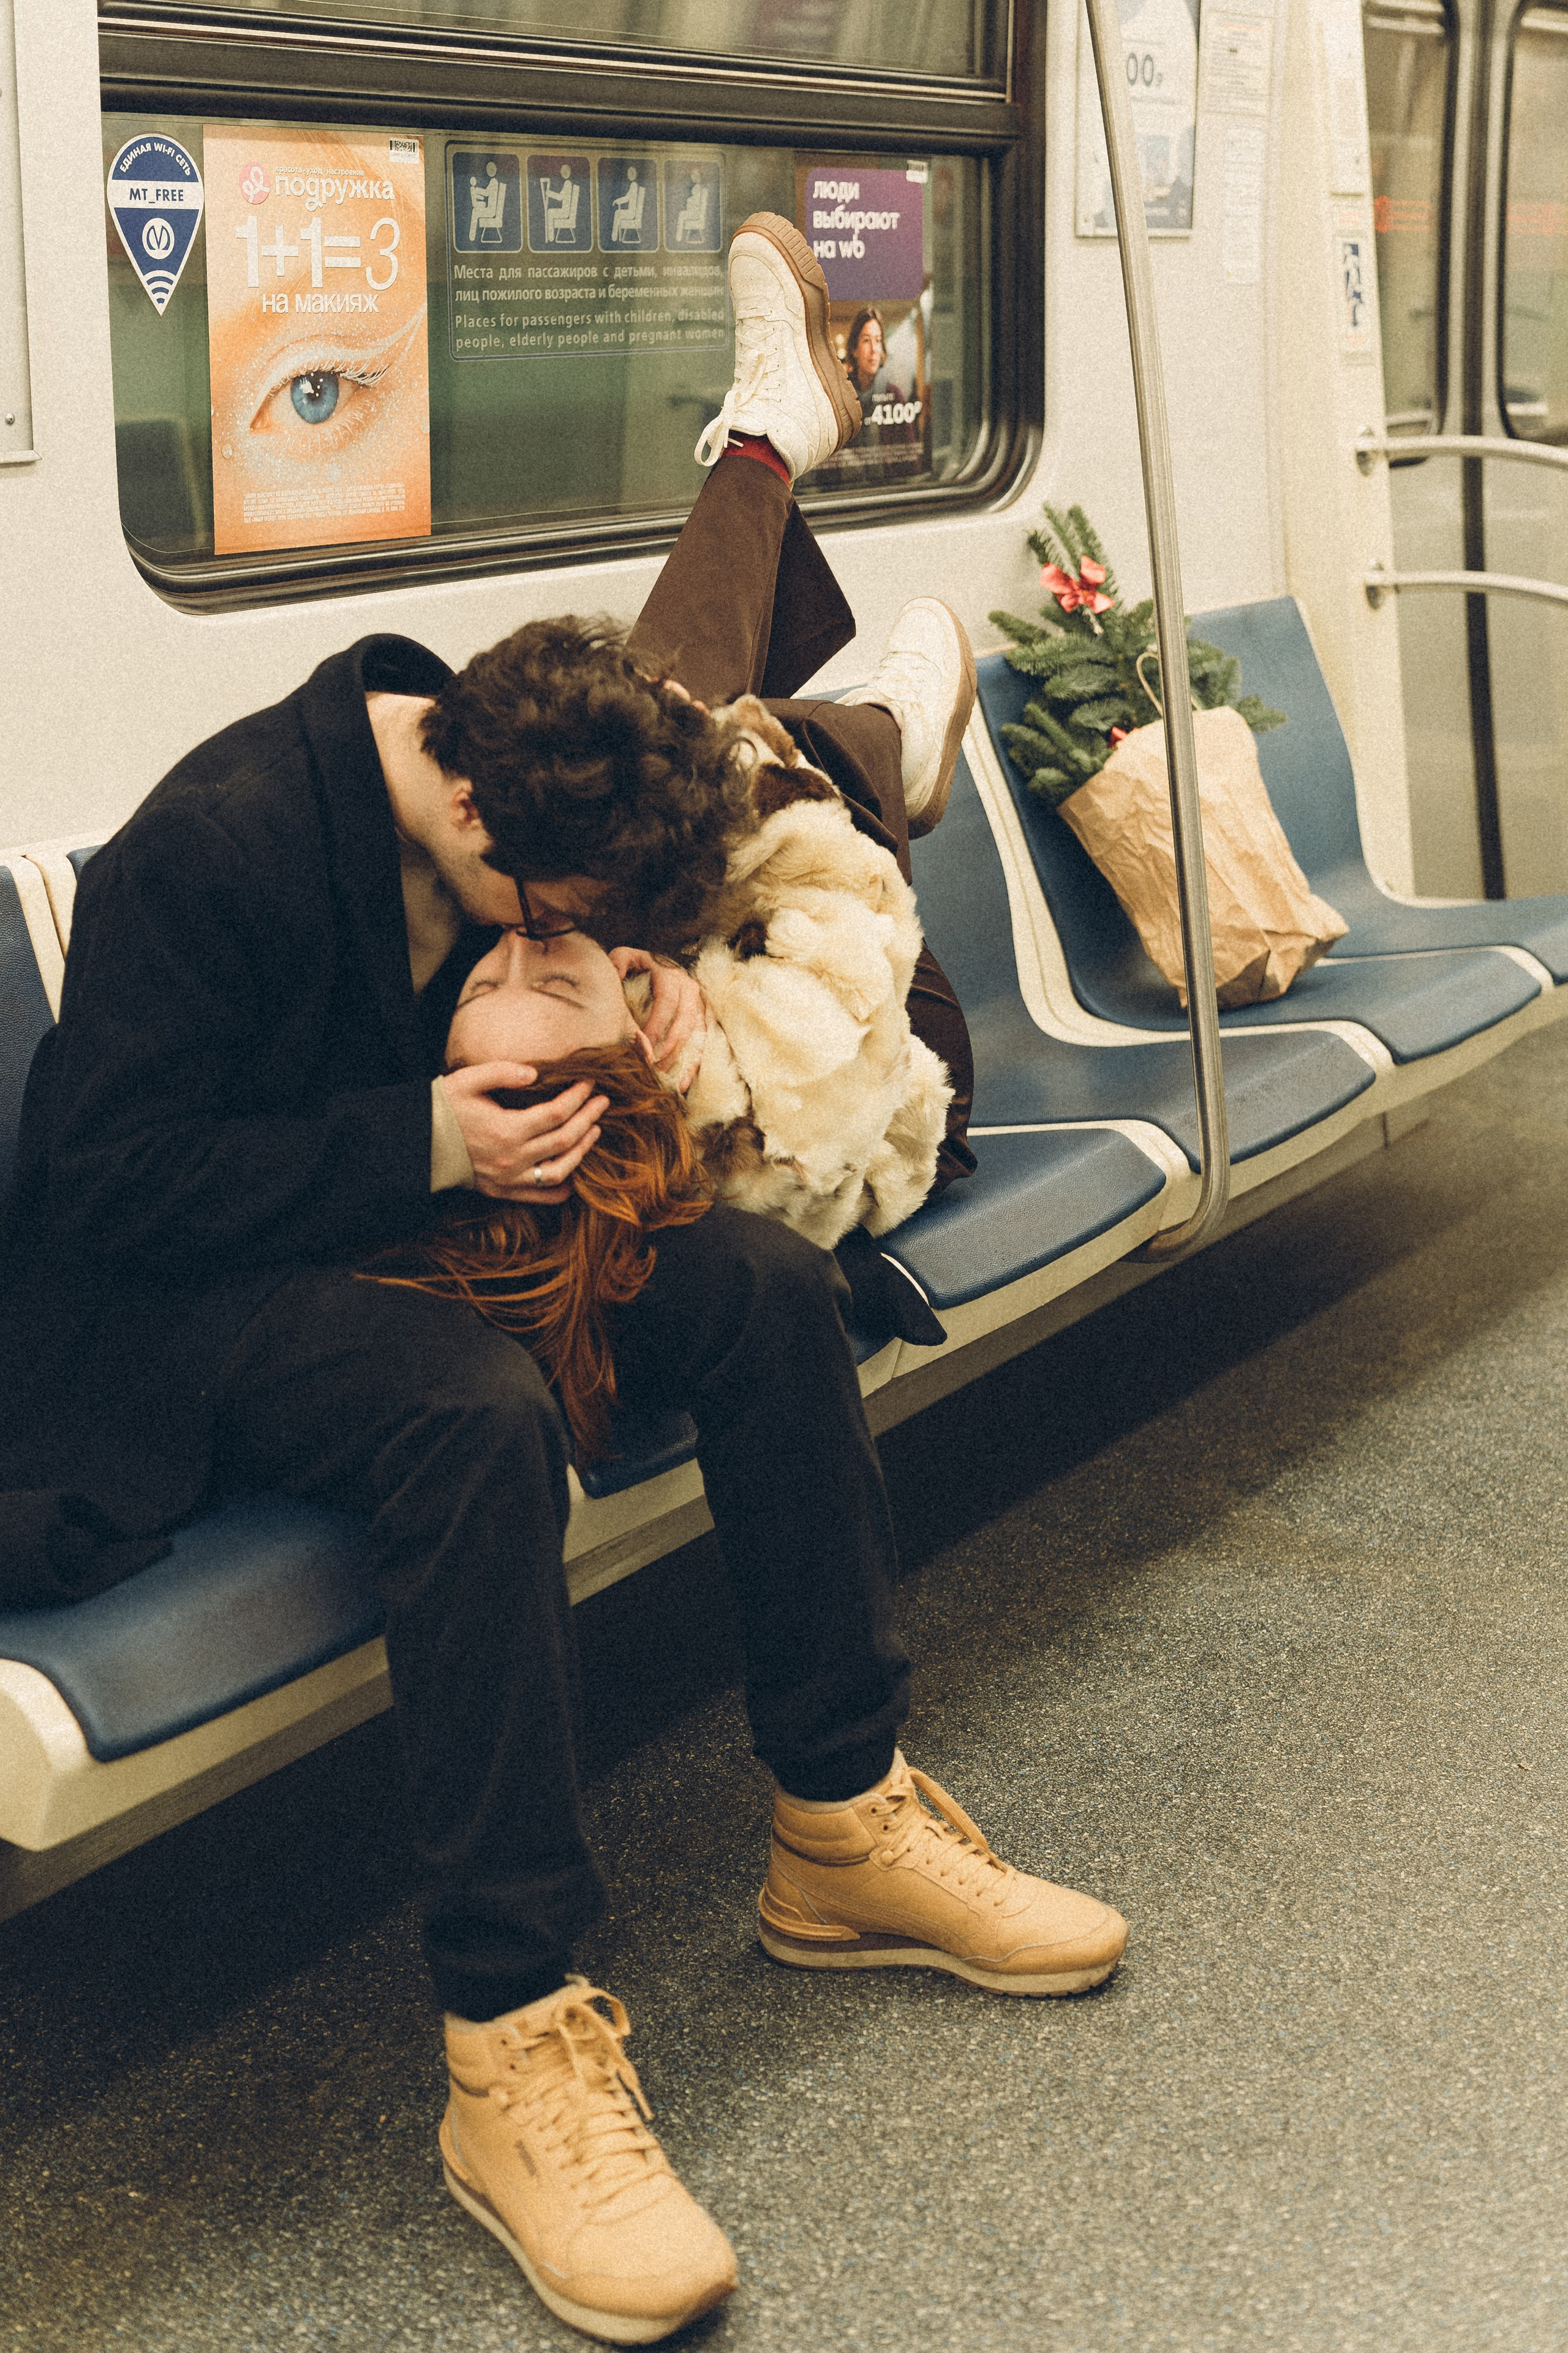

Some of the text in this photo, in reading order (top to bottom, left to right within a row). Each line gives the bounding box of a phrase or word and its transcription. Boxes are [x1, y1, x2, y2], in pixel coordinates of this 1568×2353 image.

[119, 142, 191, 176] ЕДИНАЯ WI-FI СЕТЬ
[275, 165, 365, 177] красота уход настроение
[129, 187, 184, 204] MT_FREE
[275, 175, 396, 212] подружка
[812, 180, 860, 203] люди
[813, 203, 901, 235] выбирают
[235, 215, 401, 291] 1+1=3
[813, 233, 866, 259] на wb
[454, 264, 494, 279] Места
[498, 266, 522, 281] для
[527, 265, 598, 281] пассажиров
[603, 266, 609, 277] с
[613, 265, 657, 279] детьми,
[262, 293, 380, 314] на макияж
[454, 289, 480, 303] лиц
[482, 289, 542, 301] пожилого
[545, 287, 596, 303] возраста
[598, 287, 606, 298] и
[608, 284, 678, 301] беременных
[455, 307, 725, 330] Places for passengers with children, disabled
[456, 328, 725, 352] people, elderly people and pregnant women
